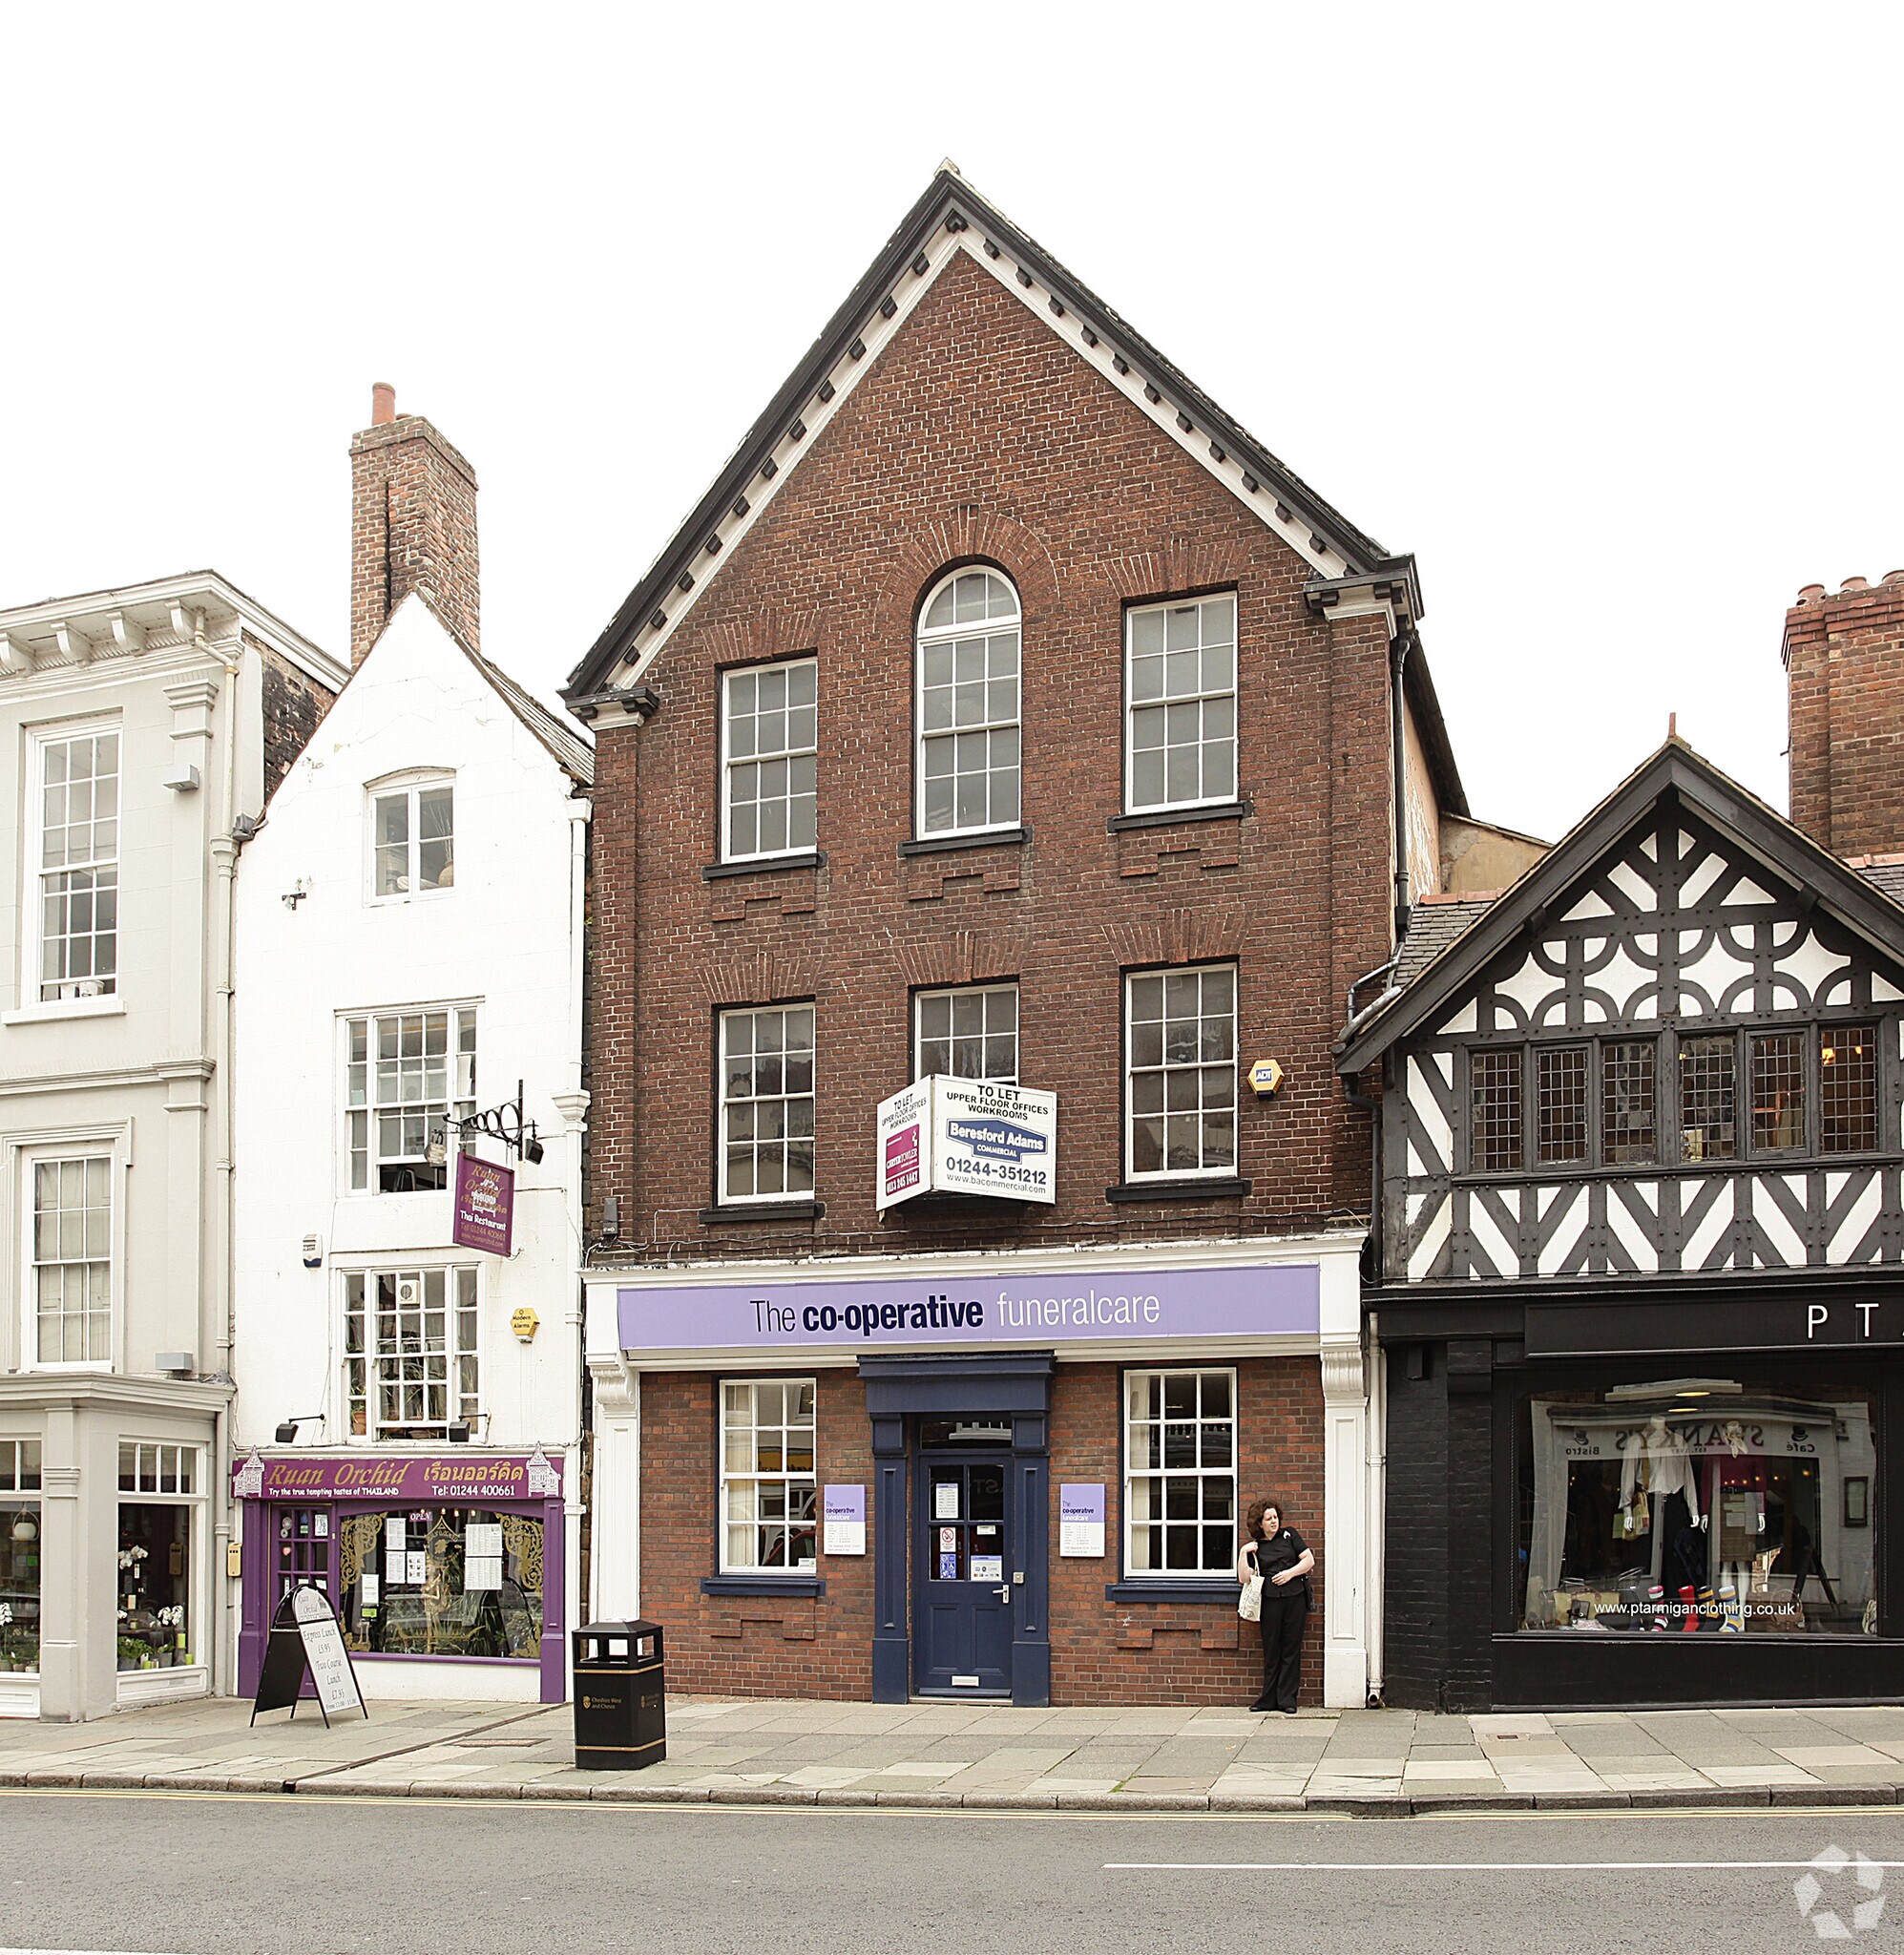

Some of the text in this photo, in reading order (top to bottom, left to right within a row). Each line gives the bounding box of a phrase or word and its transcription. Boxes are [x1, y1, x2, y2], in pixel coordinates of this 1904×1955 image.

[1257, 1070, 1272, 1080] ADT
[977, 1085, 1020, 1101] TO LET
[894, 1093, 913, 1111] TO LET
[947, 1091, 1049, 1115] UPPER FLOOR OFFICES
[882, 1097, 927, 1126] UPPER FLOOR OFFICES
[968, 1104, 1028, 1121] WORKROOMS
[890, 1111, 917, 1130] WORKROOMS
[950, 1122, 1044, 1150] Beresford Adams
[976, 1145, 1017, 1157] COMMERCIAL
[946, 1157, 1047, 1186] 01244-351212
[947, 1173, 1046, 1194] www.bacommercial.com
[460, 1210, 507, 1231] Thai Restaurant
[749, 1289, 1161, 1336] The co-operative funeralcare
[266, 1461, 414, 1485] Ruan Orchid
[269, 1487, 279, 1497] Try
[281, 1487, 291, 1496] the
[306, 1487, 333, 1497] tempting
[353, 1487, 361, 1496] of
[362, 1487, 399, 1496] THAILAND
[431, 1485, 515, 1496] Tel: 01244 400661
[410, 1512, 431, 1521] OPEN
[1594, 1601, 1795, 1617] www.ptarmiganclothing.co.uk
[322, 1626, 337, 1638] Lunch
[326, 1673, 342, 1686] Lunch
